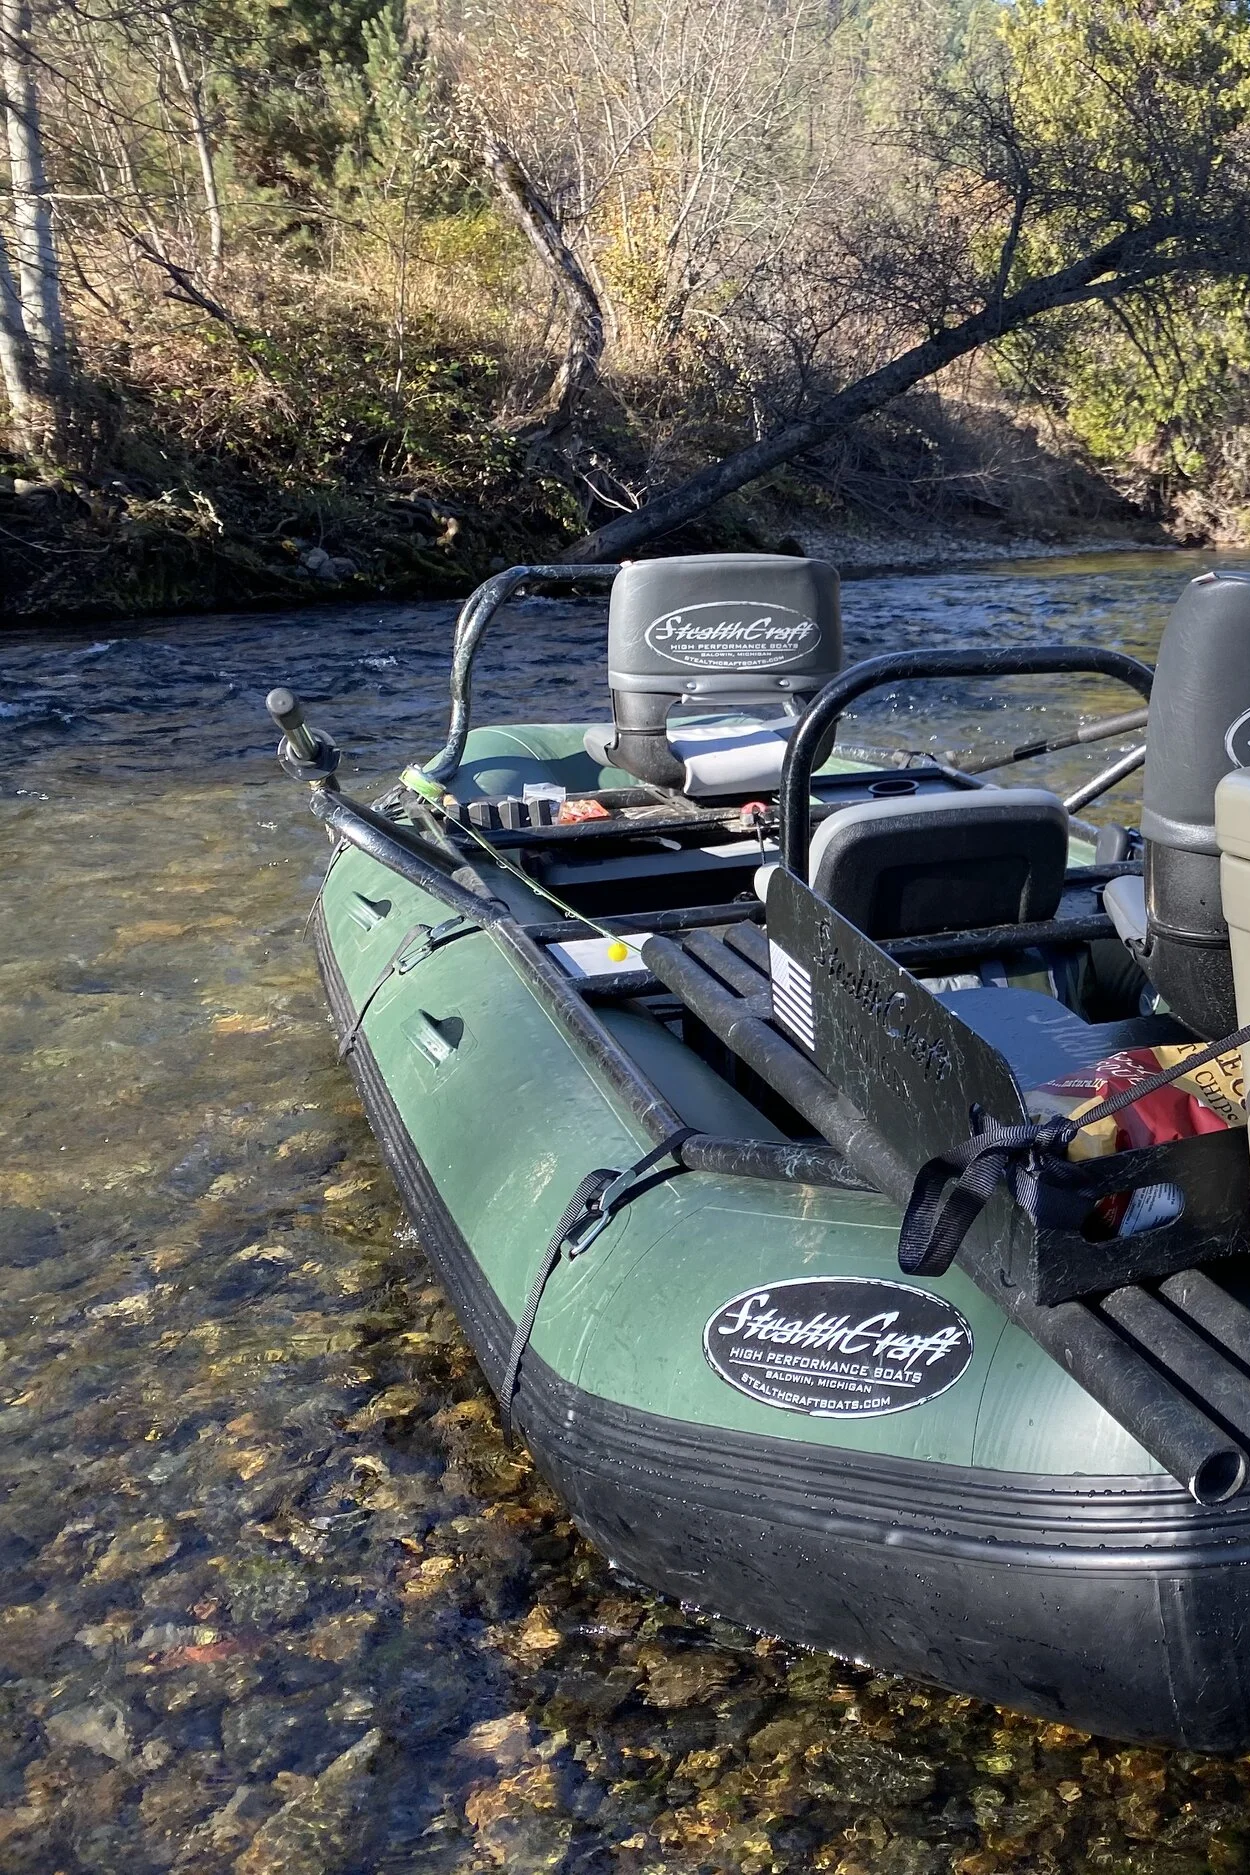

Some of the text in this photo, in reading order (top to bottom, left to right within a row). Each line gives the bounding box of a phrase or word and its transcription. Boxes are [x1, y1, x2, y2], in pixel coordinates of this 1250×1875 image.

[670, 643, 695, 651] HIGH
[769, 642, 799, 650] BOATS
[729, 1346, 923, 1384] HIGH PERFORMANCE BOATS
[740, 1371, 891, 1410] STEALTHCRAFTBOATS.COM
[765, 1370, 872, 1394] BALDWIN, MICHIGAN
